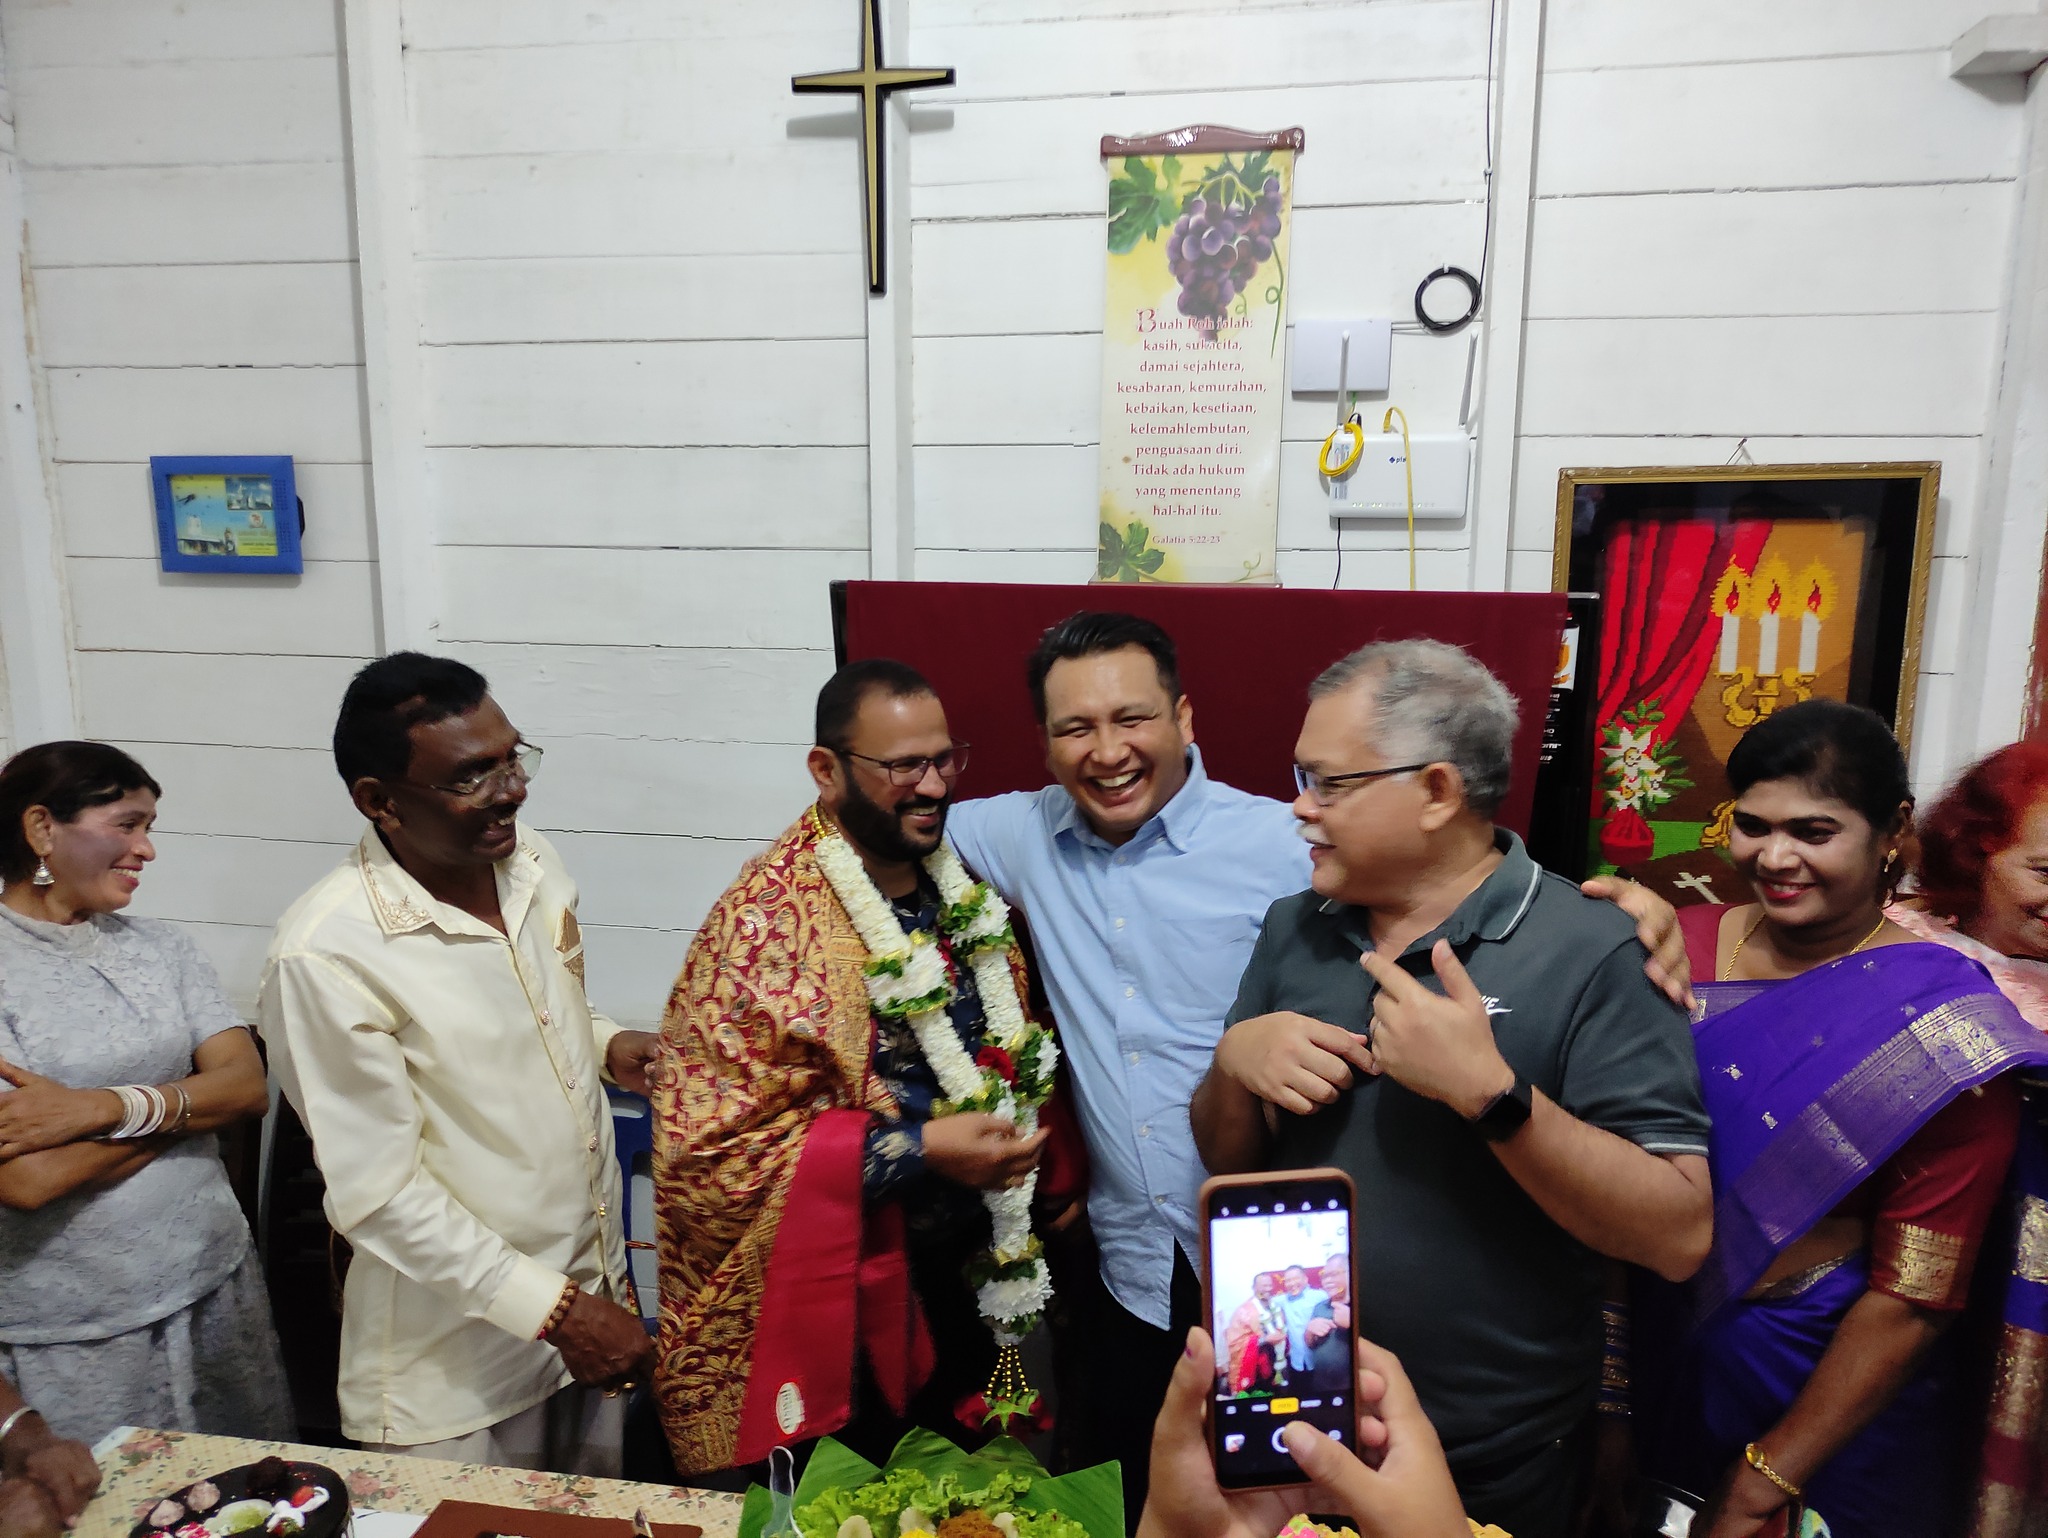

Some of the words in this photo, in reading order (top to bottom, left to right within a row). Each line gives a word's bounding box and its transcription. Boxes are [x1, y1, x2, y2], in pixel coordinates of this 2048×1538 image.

[1137, 308, 1183, 333] Buah
[1188, 318, 1213, 330] Roh
[1217, 317, 1253, 330] ialah:
[1144, 340, 1181, 352] kasih,
[1185, 340, 1242, 351] sukacita,
[1140, 361, 1178, 372] damai
[1184, 360, 1245, 374] sejahtera,
[1117, 382, 1185, 394] kesabaran,
[1189, 381, 1267, 393] kemurahan,
[1126, 403, 1188, 415] kebaikan,
[1192, 403, 1257, 414] kesetiaan,
[1130, 423, 1250, 435] kelemahlembutan,
[1136, 444, 1211, 458] penguasaan
[1215, 443, 1242, 455] diri.
[1132, 464, 1169, 476] Tidak
[1173, 464, 1195, 476] ada
[1199, 464, 1245, 476] hukum
[1136, 487, 1166, 499] yang
[1170, 486, 1241, 498] menentang
[1153, 505, 1197, 516] hal-hal
[1201, 505, 1222, 516] itu.
[1152, 536, 1186, 544] Galatia
